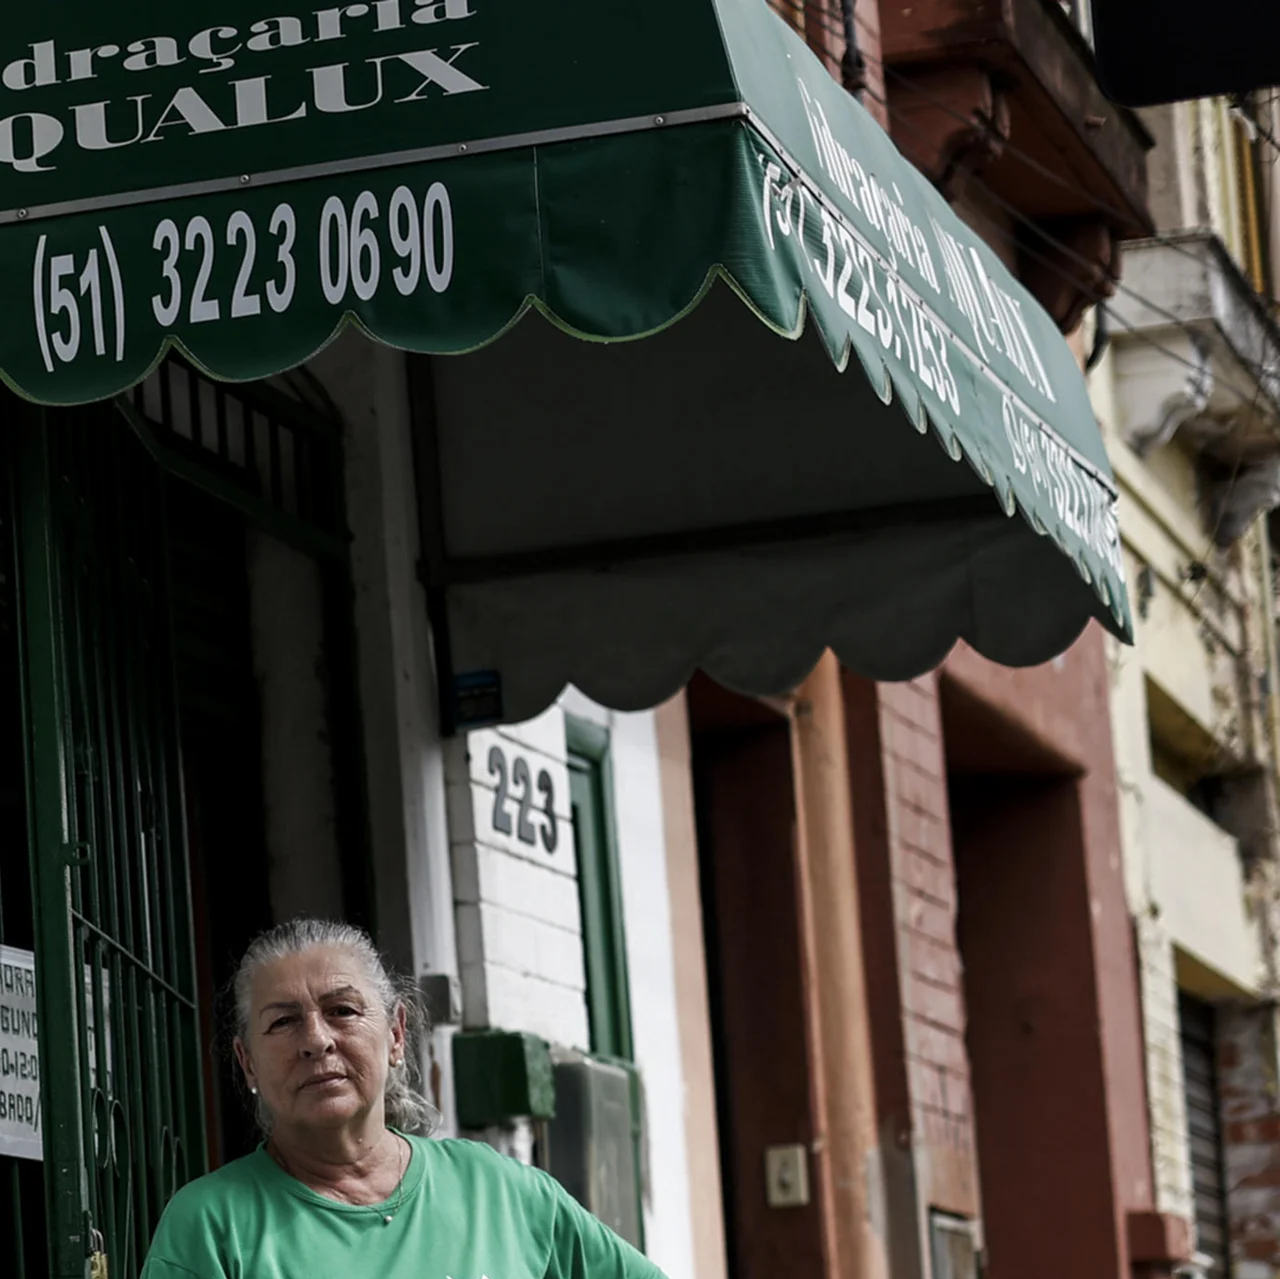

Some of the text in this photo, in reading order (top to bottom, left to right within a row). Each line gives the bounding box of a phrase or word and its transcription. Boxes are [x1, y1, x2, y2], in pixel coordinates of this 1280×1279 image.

[33, 182, 454, 372] (51) 3223 0690
[488, 745, 559, 855] 223
